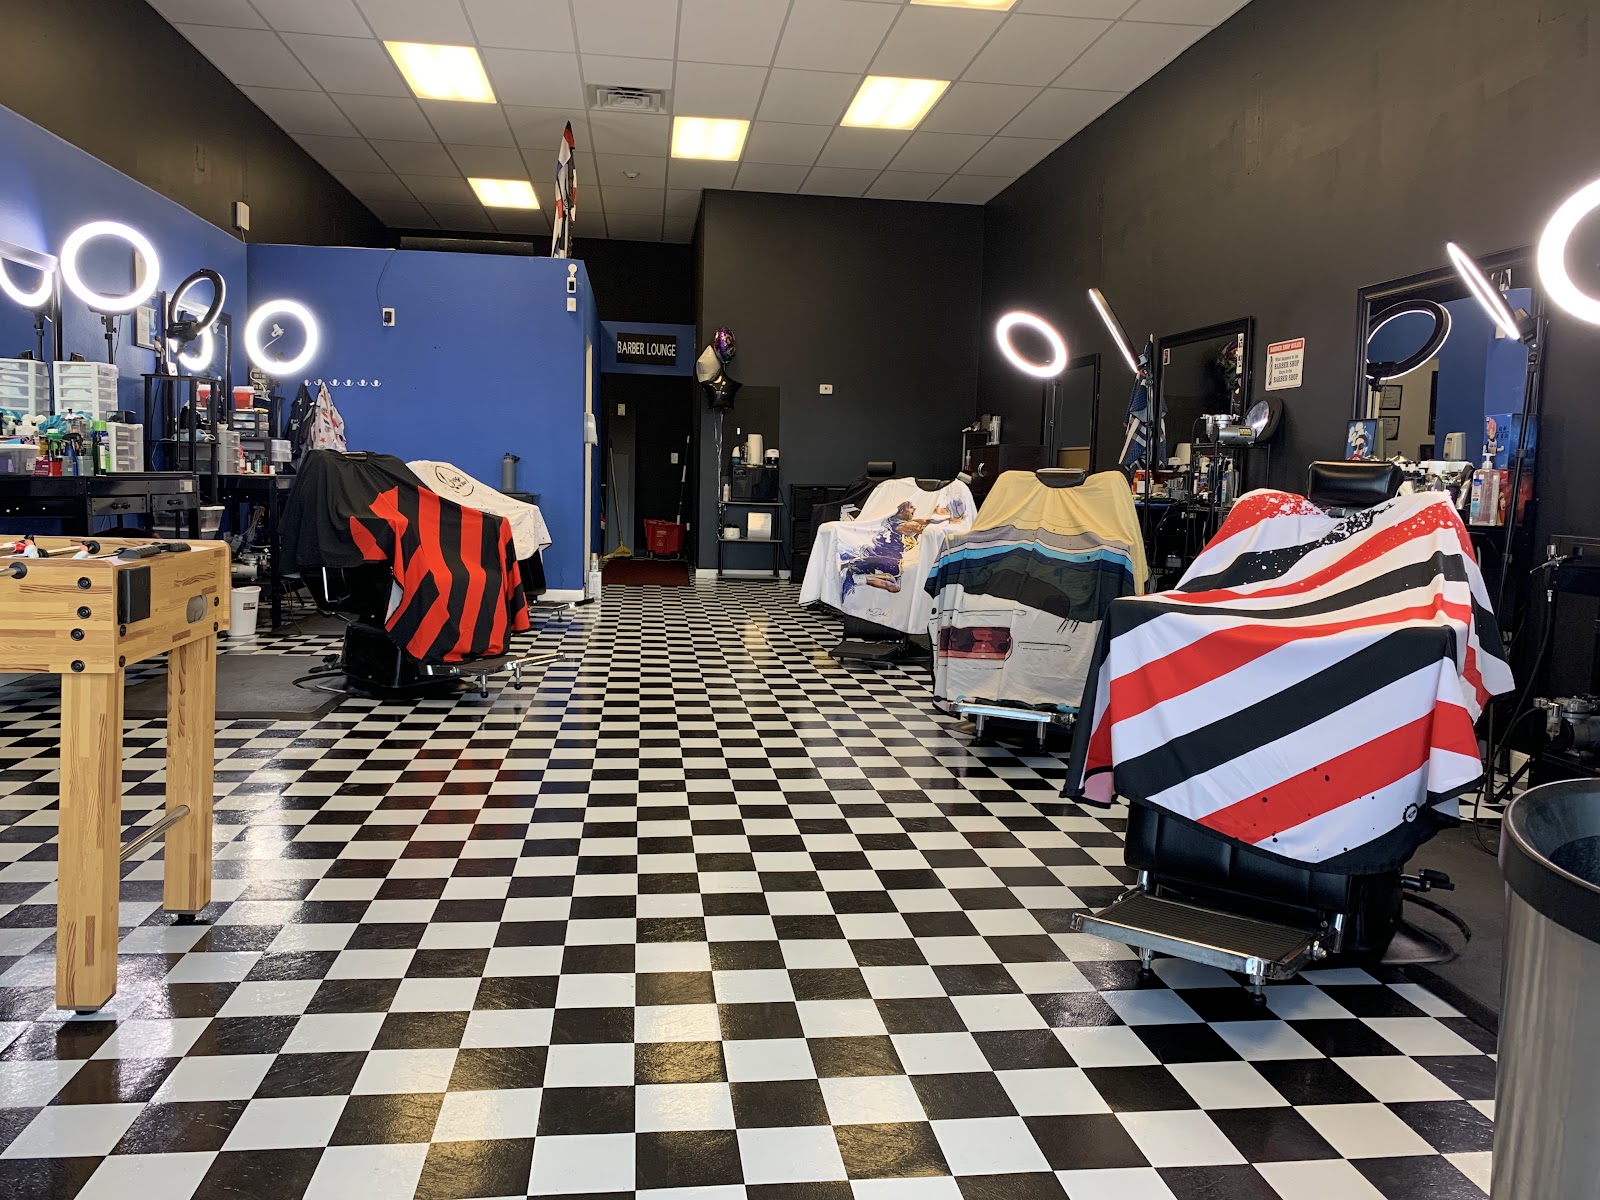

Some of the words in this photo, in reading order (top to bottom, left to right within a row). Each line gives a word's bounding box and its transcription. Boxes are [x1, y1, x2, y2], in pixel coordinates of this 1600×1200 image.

[617, 341, 645, 355] BARBER
[646, 343, 676, 356] LOUNGE
[1274, 361, 1288, 369] BARBER
[1290, 359, 1299, 367] SHOP
[1273, 375, 1288, 383] BARBER
